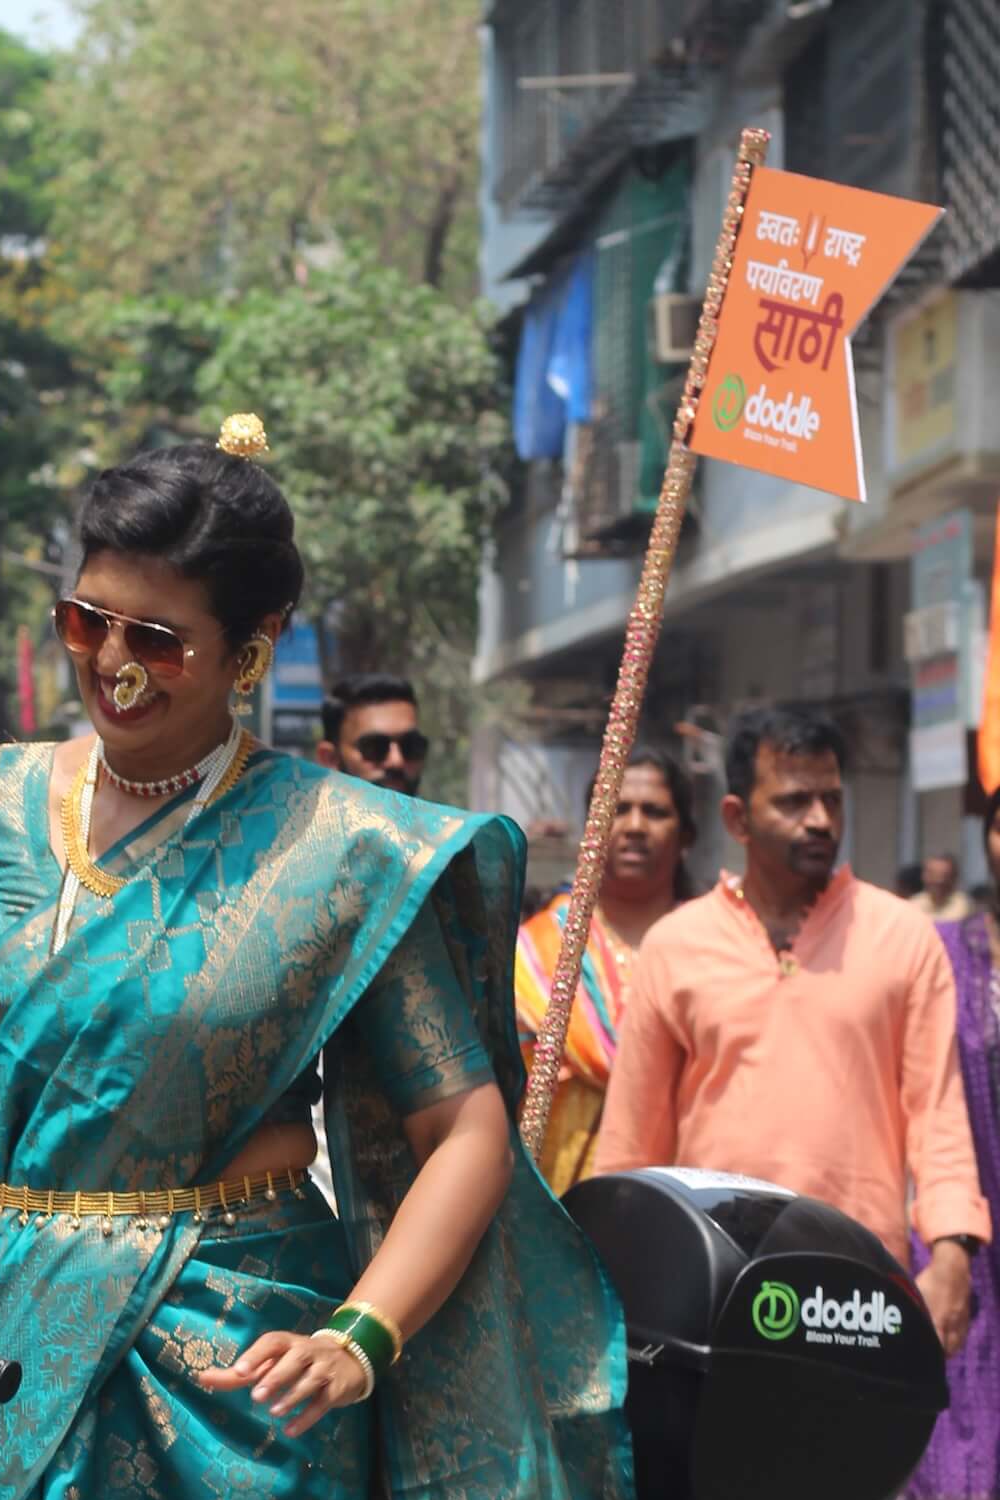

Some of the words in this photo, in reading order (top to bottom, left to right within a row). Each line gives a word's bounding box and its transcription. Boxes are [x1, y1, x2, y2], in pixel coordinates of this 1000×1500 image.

[756, 210, 801, 248] स्वतः
[754, 292, 845, 373] साठी
[744, 383, 821, 441] doddle
[801, 1285, 902, 1334] doddle
[834, 1332, 857, 1346] Your
